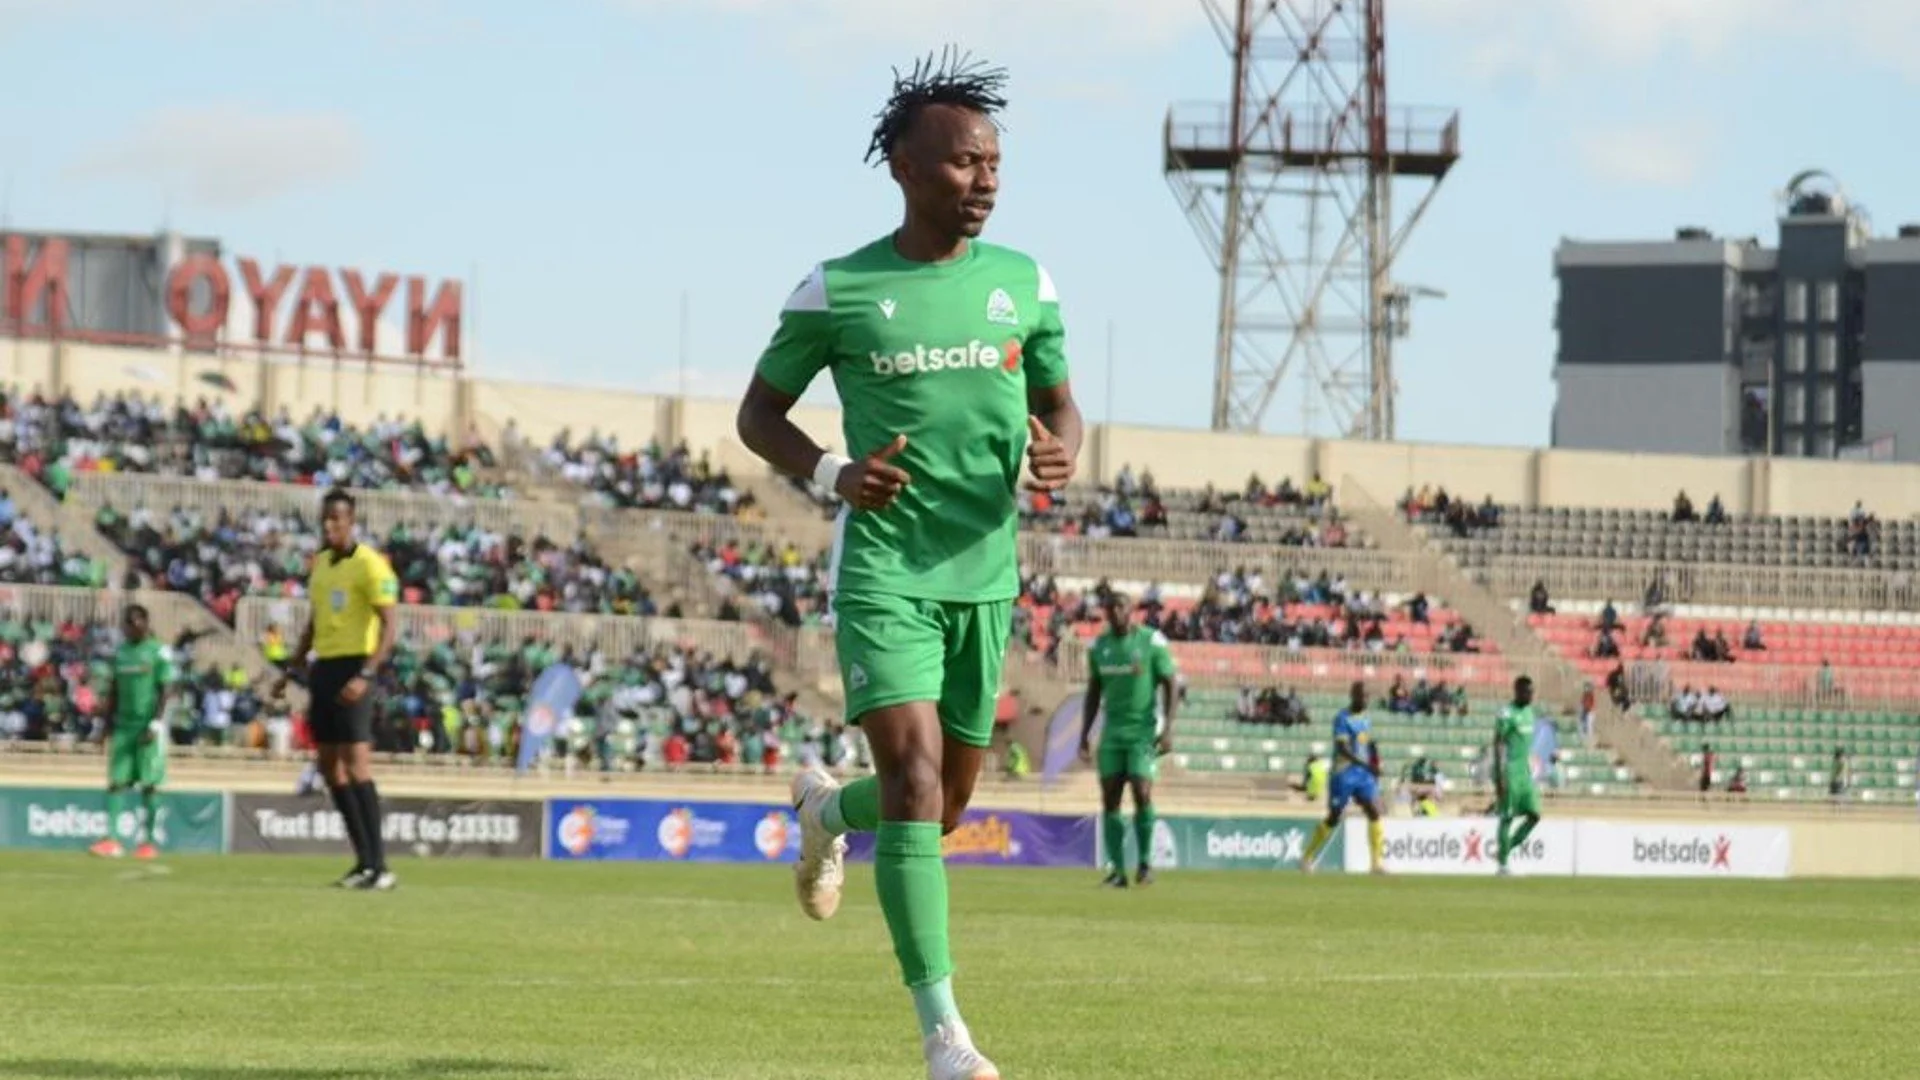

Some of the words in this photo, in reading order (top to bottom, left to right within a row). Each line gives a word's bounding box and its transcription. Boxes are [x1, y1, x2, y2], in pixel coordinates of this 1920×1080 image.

[869, 339, 1000, 375] betsafe
[28, 803, 136, 837] betsae
[256, 809, 310, 839] Text
[418, 815, 447, 842] to
[1206, 829, 1284, 858] betsafe
[1632, 835, 1711, 863] betsafe
